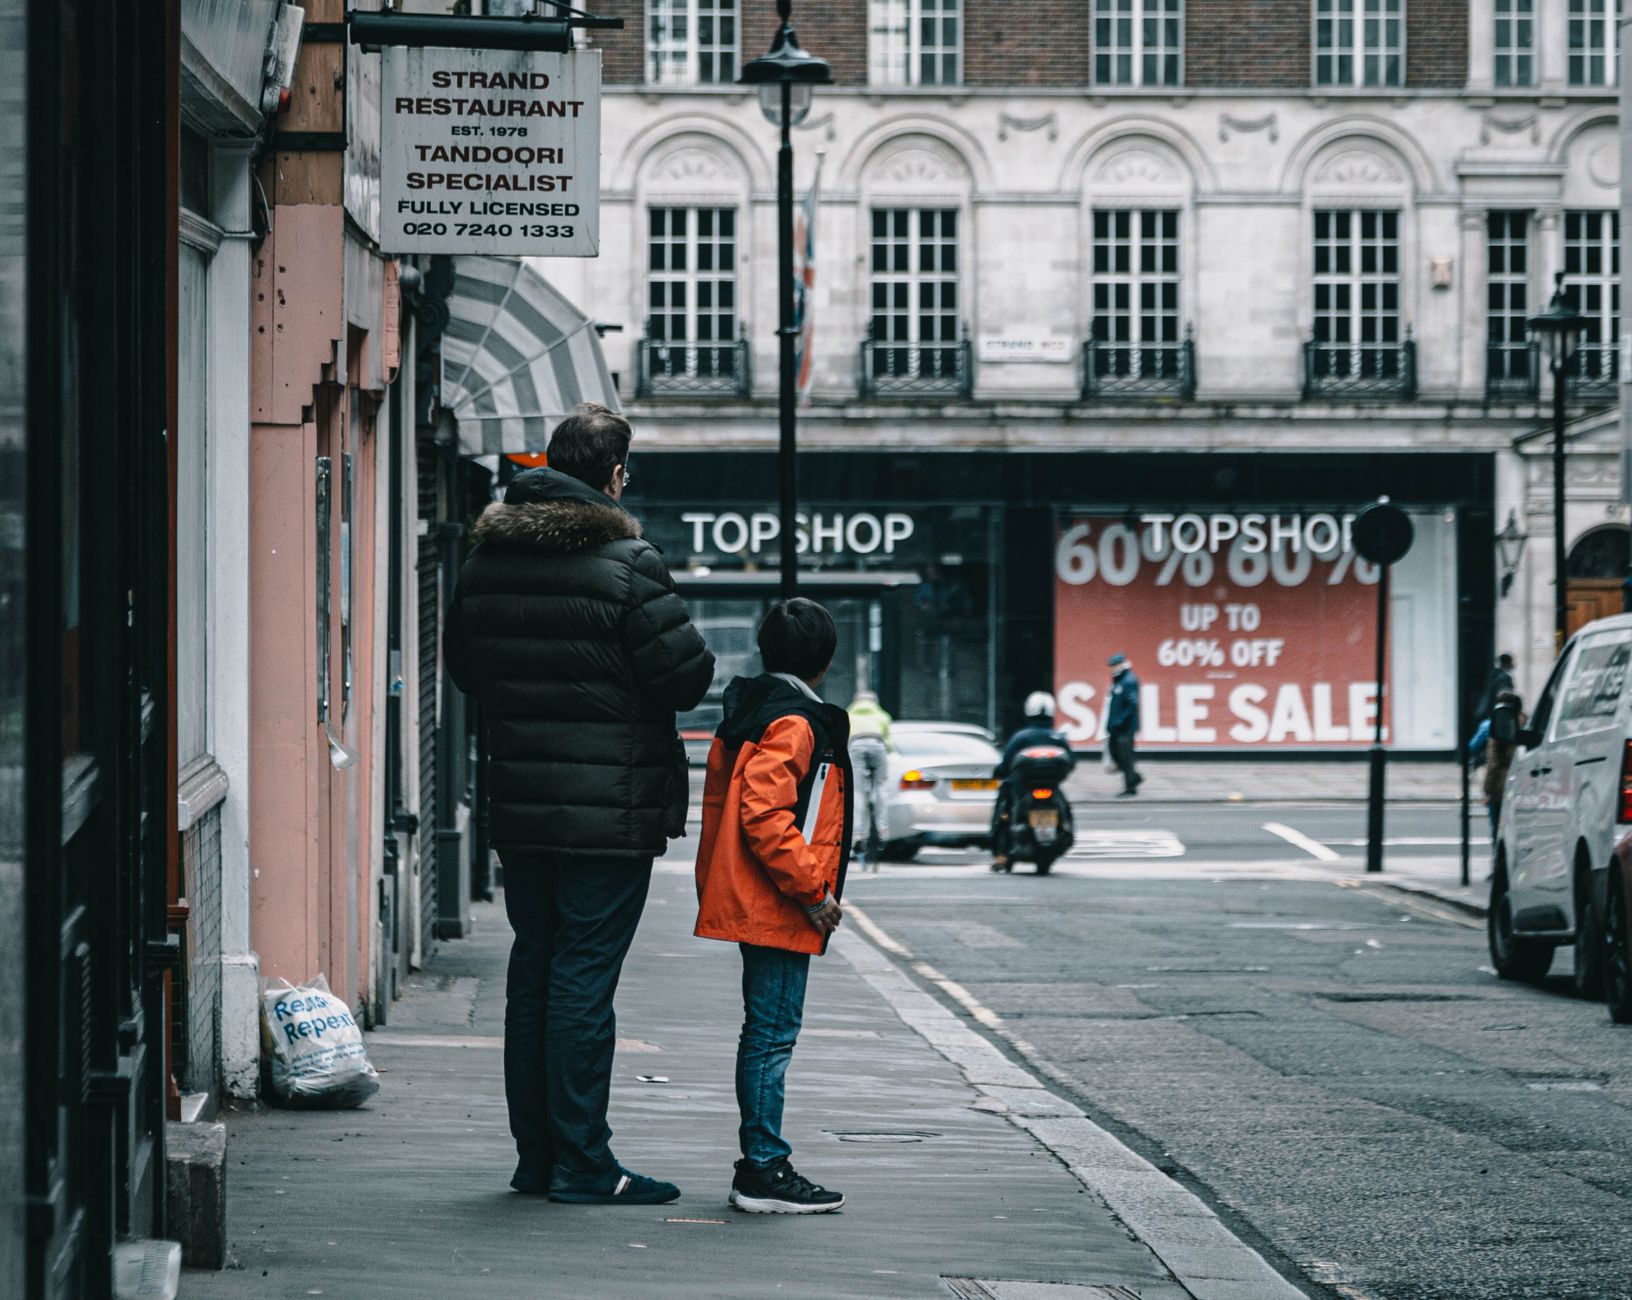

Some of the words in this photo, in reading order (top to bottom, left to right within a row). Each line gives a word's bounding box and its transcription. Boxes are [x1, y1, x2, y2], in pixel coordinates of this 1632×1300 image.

[432, 71, 549, 90] STRAND
[395, 98, 584, 117] RESTAURANT
[451, 126, 483, 136] EST.
[489, 127, 528, 137] 1978
[415, 145, 563, 164] TANDOORI
[406, 172, 573, 192] SPECIALIST
[398, 201, 463, 215] FULLY
[470, 202, 580, 216] LICENSED
[403, 223, 447, 236] 020
[454, 223, 513, 237] 7240
[520, 225, 574, 238] 1333
[682, 512, 914, 553] TOPSHOP
[1180, 604, 1219, 631] UP
[1225, 603, 1261, 631] TO
[1157, 639, 1224, 667] 60%
[1231, 639, 1284, 667] OFF
[1057, 682, 1217, 742] SLE
[1229, 682, 1389, 742] SALE
